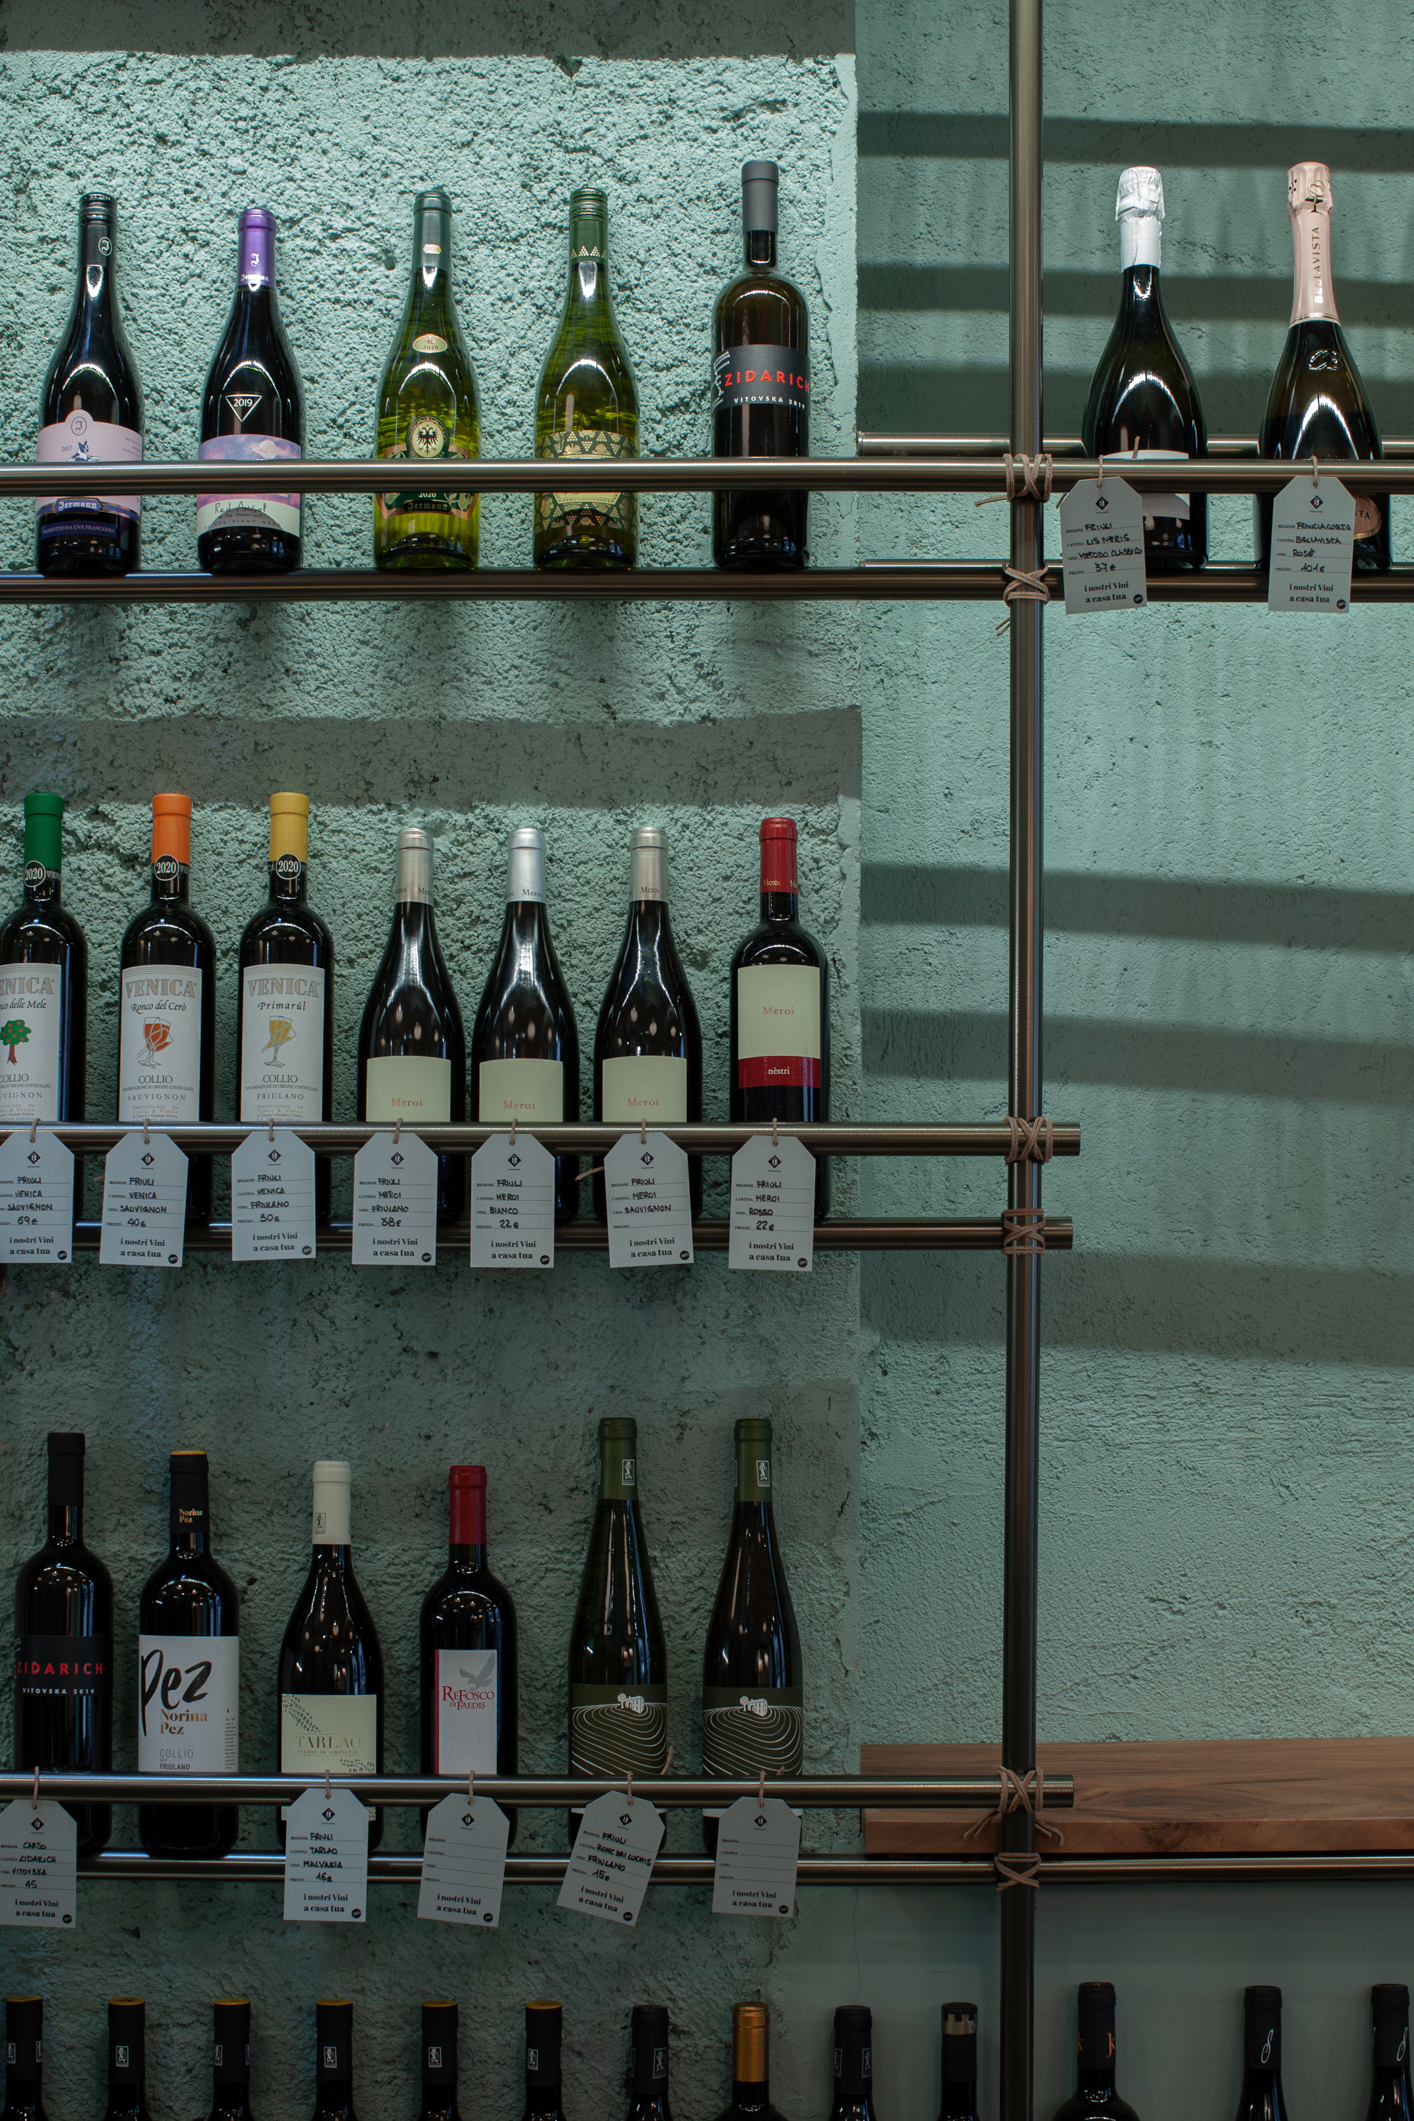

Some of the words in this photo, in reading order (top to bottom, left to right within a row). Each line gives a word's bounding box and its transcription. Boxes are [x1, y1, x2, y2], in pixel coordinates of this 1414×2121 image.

[1312, 226, 1323, 304] BELLAVISTA
[725, 370, 810, 393] ZIDARICH
[233, 399, 253, 407] 2019
[788, 399, 805, 410] 2019
[58, 501, 97, 511] Jermann
[215, 502, 231, 514] Red
[42, 525, 65, 534] PRODOTTO
[85, 525, 115, 534] FRANCONIA
[1089, 583, 1112, 592] nostri
[1113, 581, 1129, 589] Vini
[156, 862, 177, 874] 2020
[278, 860, 299, 873] 2020
[25, 868, 43, 880] 2020
[0, 977, 53, 996] NICA
[126, 979, 196, 998] VENICA
[248, 978, 319, 998] VENICA
[9, 998, 25, 1009] delle
[27, 998, 47, 1009] Mele
[131, 1003, 154, 1014] Ronco
[155, 1000, 169, 1010] del
[763, 1006, 794, 1015] Meroi
[768, 1067, 790, 1075] nèstri
[139, 1075, 173, 1084] COLLIO
[263, 1075, 298, 1083] COLLIO
[391, 1097, 423, 1107] Meroi
[504, 1100, 535, 1110] Meroi
[627, 1098, 659, 1107] Meroi
[15, 1190, 43, 1198] VENICA
[129, 1192, 157, 1200] VENICA
[490, 1206, 519, 1215] BIANCO
[17, 1662, 103, 1675] ZIDARICH
[160, 1710, 208, 1722] Norina
[160, 1722, 185, 1735] Pez
[296, 1736, 361, 1749] TARLAO
[160, 1748, 194, 1759] COLLIO
[304, 1860, 343, 1868] MALVASIA
[441, 1894, 464, 1903] nostri
[466, 1897, 481, 1905] Vini
[463, 1907, 477, 1915] tua
